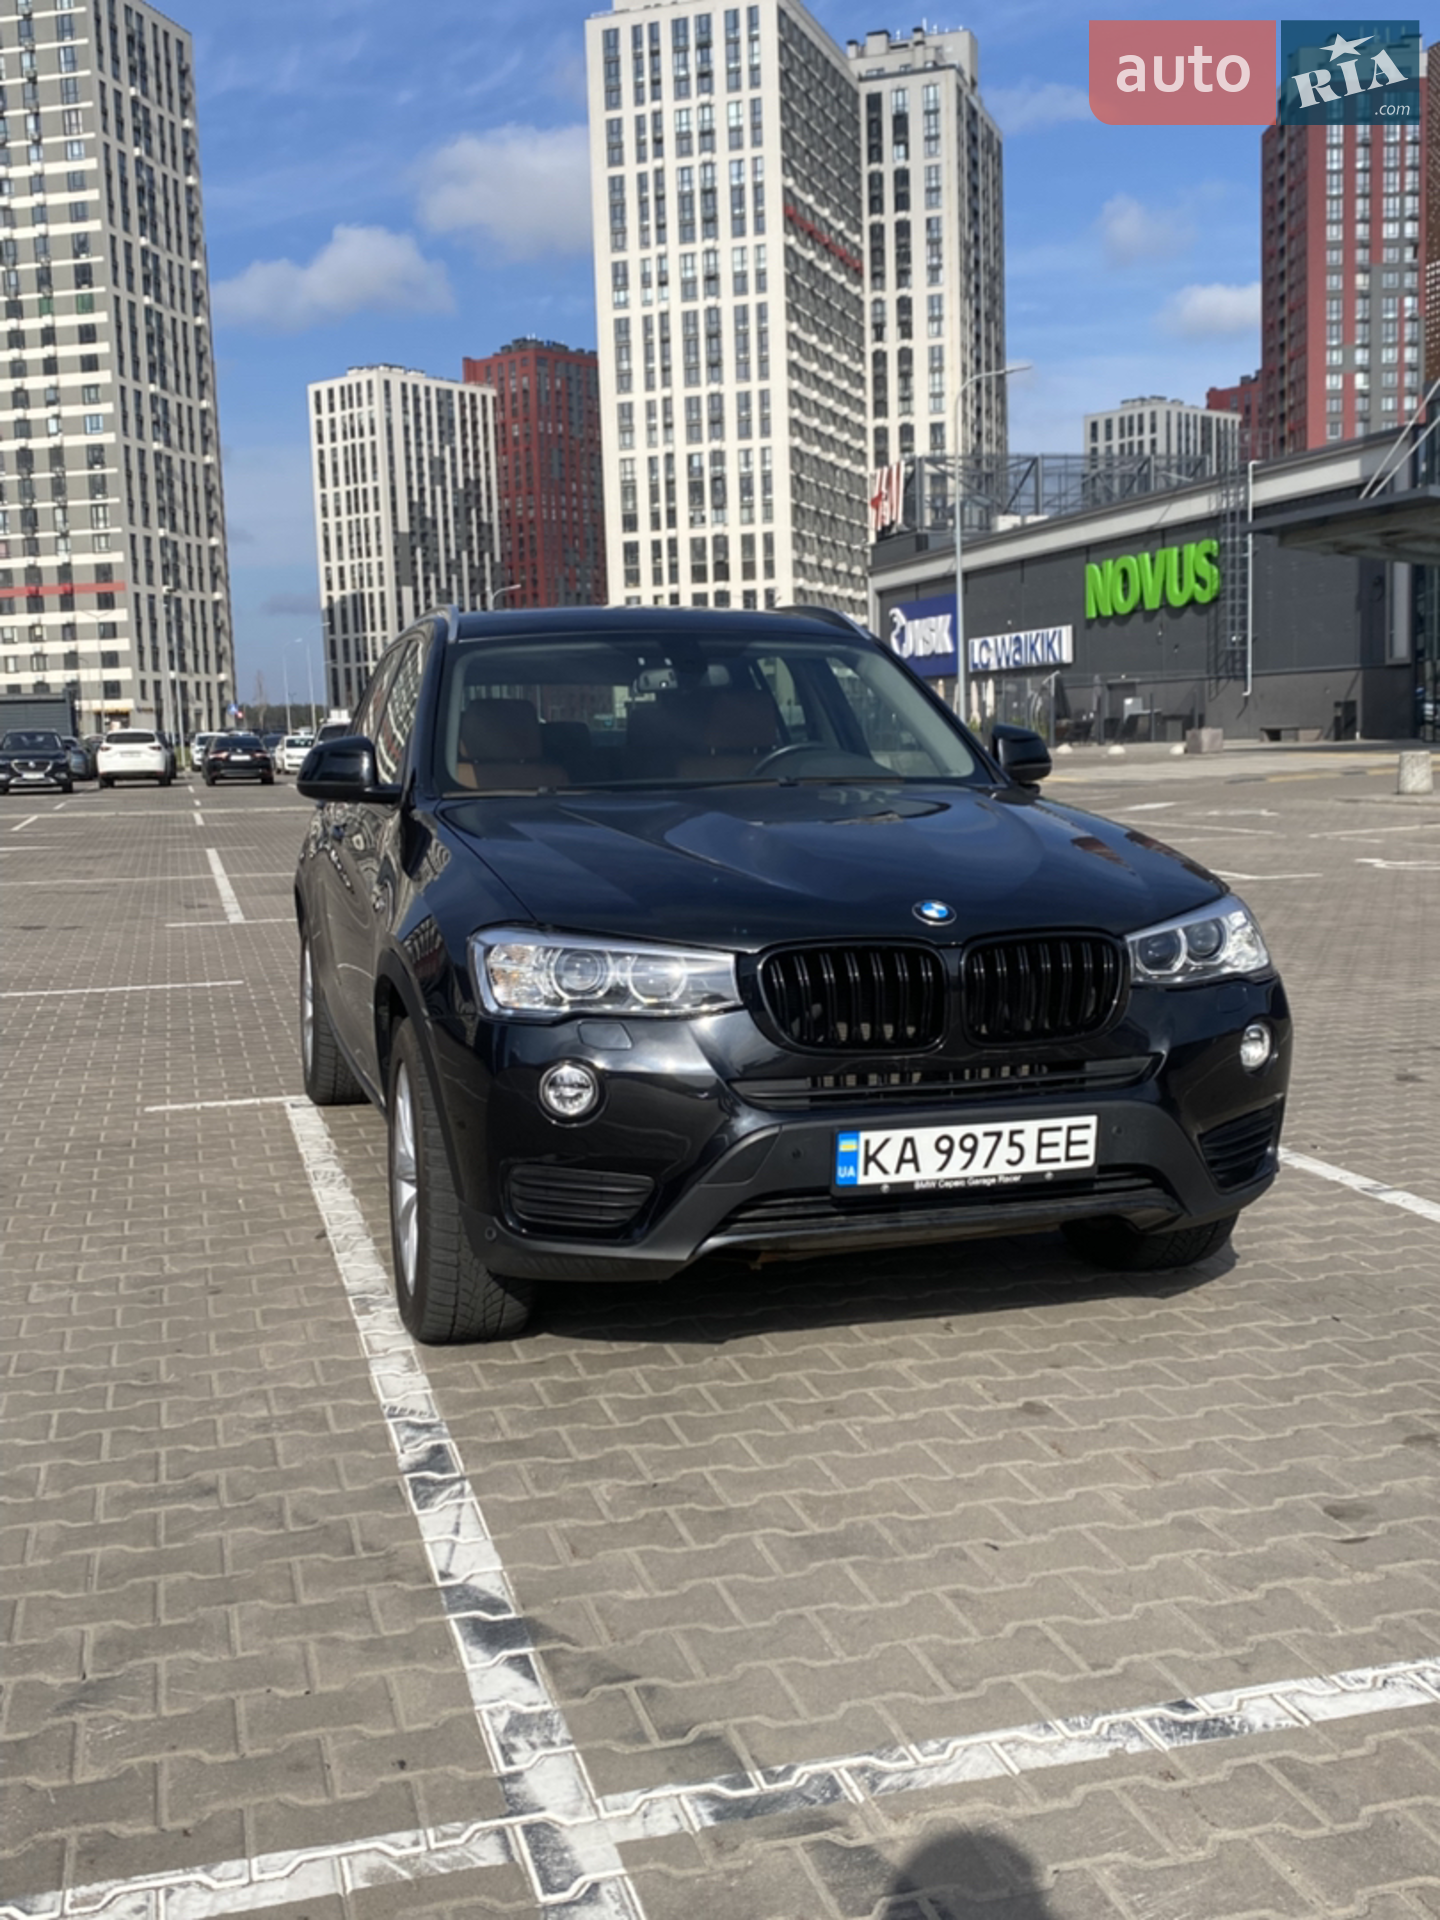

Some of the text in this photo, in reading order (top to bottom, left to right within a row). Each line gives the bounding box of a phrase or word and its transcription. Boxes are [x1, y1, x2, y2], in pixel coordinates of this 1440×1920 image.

[1085, 539, 1219, 619] NOVUS
[900, 613, 954, 658] JYSK
[971, 640, 992, 669] LC
[838, 1165, 856, 1178] UA
[862, 1124, 1092, 1176] KA 9975 EE
